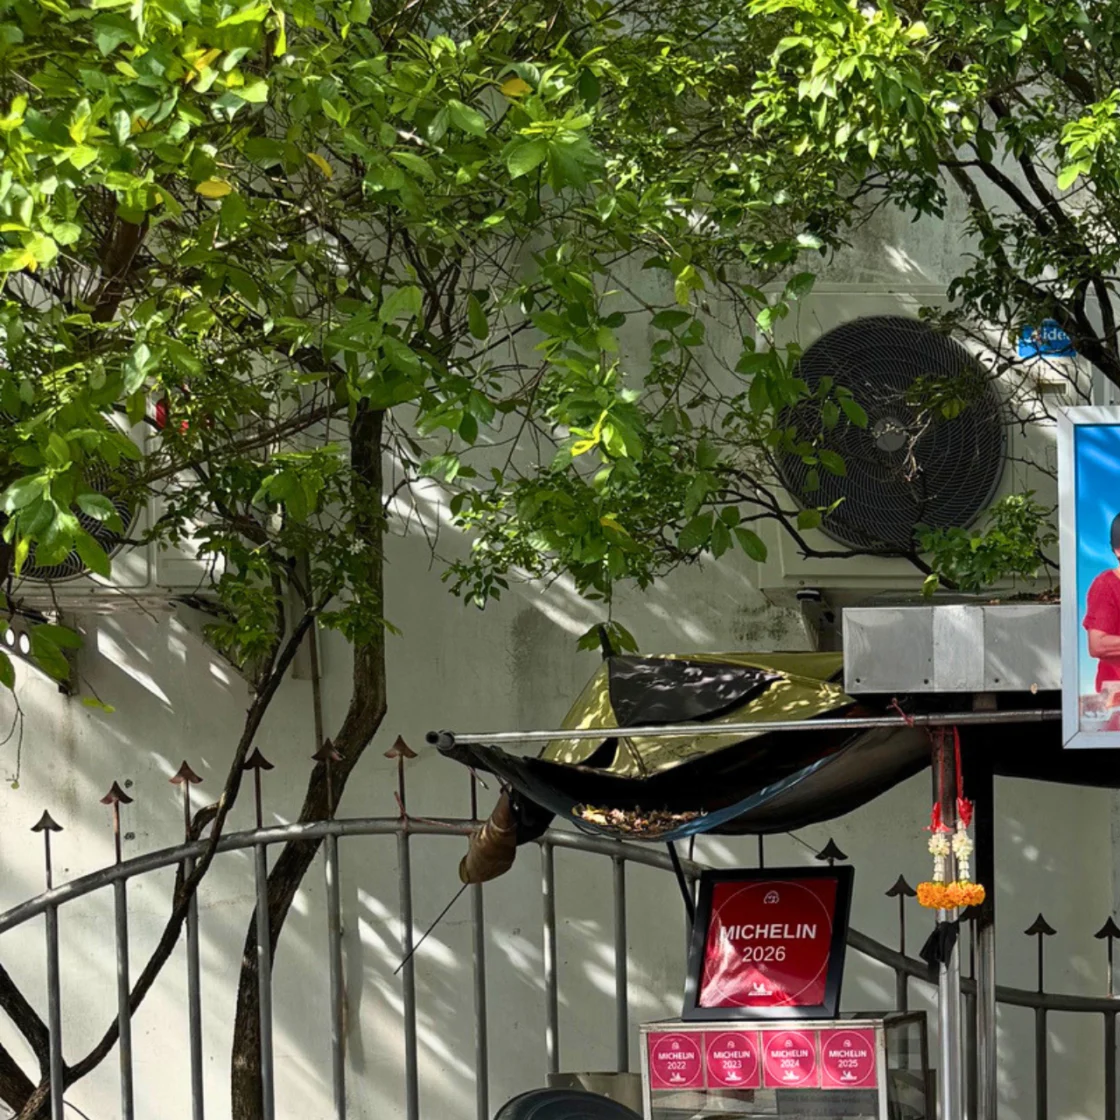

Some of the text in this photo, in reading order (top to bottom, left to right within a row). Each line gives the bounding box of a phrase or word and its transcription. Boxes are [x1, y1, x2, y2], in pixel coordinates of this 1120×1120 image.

[720, 924, 817, 940] MICHELIN
[742, 946, 786, 962] 2026
[658, 1052, 694, 1060] MICHELIN
[713, 1051, 750, 1059] MICHELIN
[771, 1050, 808, 1058] MICHELIN
[829, 1050, 867, 1058] MICHELIN
[667, 1061, 686, 1070] 2022
[722, 1060, 742, 1069] 2023
[780, 1059, 799, 1068] 2024
[838, 1059, 858, 1068] 2025
